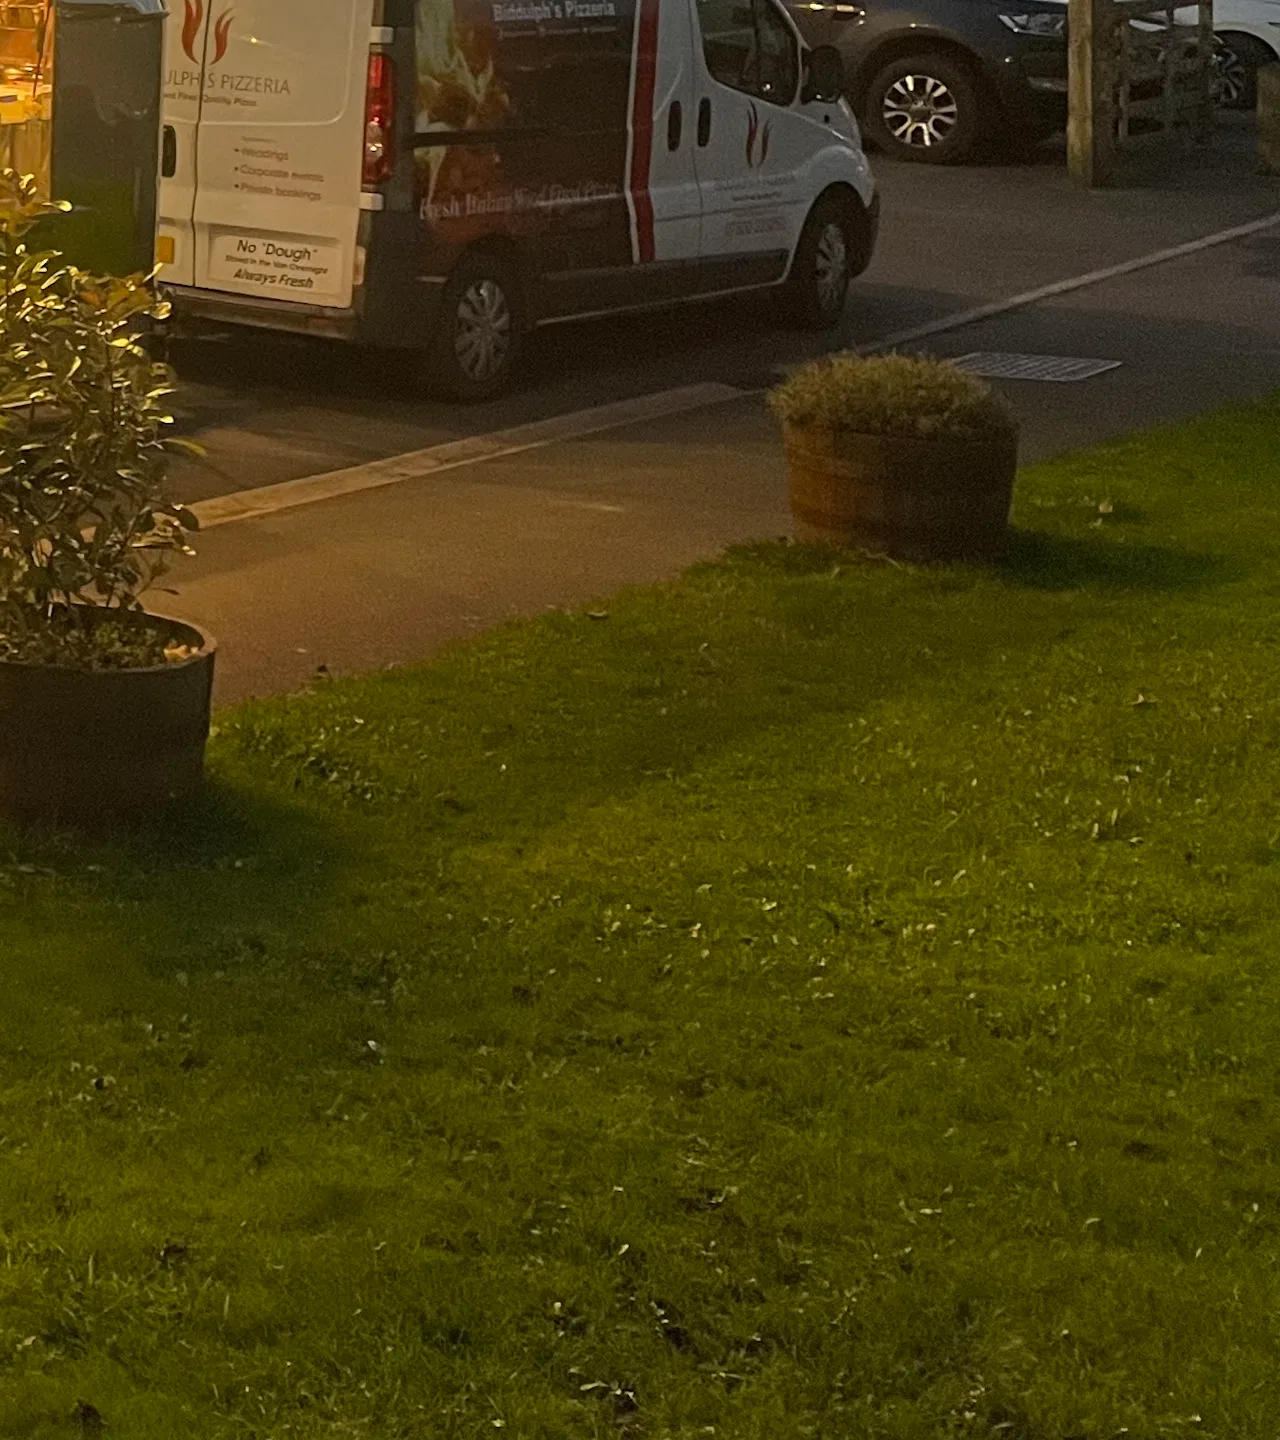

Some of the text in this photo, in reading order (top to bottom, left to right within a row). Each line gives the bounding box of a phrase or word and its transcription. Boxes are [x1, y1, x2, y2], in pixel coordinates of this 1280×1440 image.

[564, 0, 616, 18] Pizzeria
[220, 73, 291, 95] PIZZERIA
[240, 164, 290, 179] Corporate
[275, 186, 322, 202] bookings
[236, 239, 257, 254] No
[233, 268, 315, 289] Always Fresh
